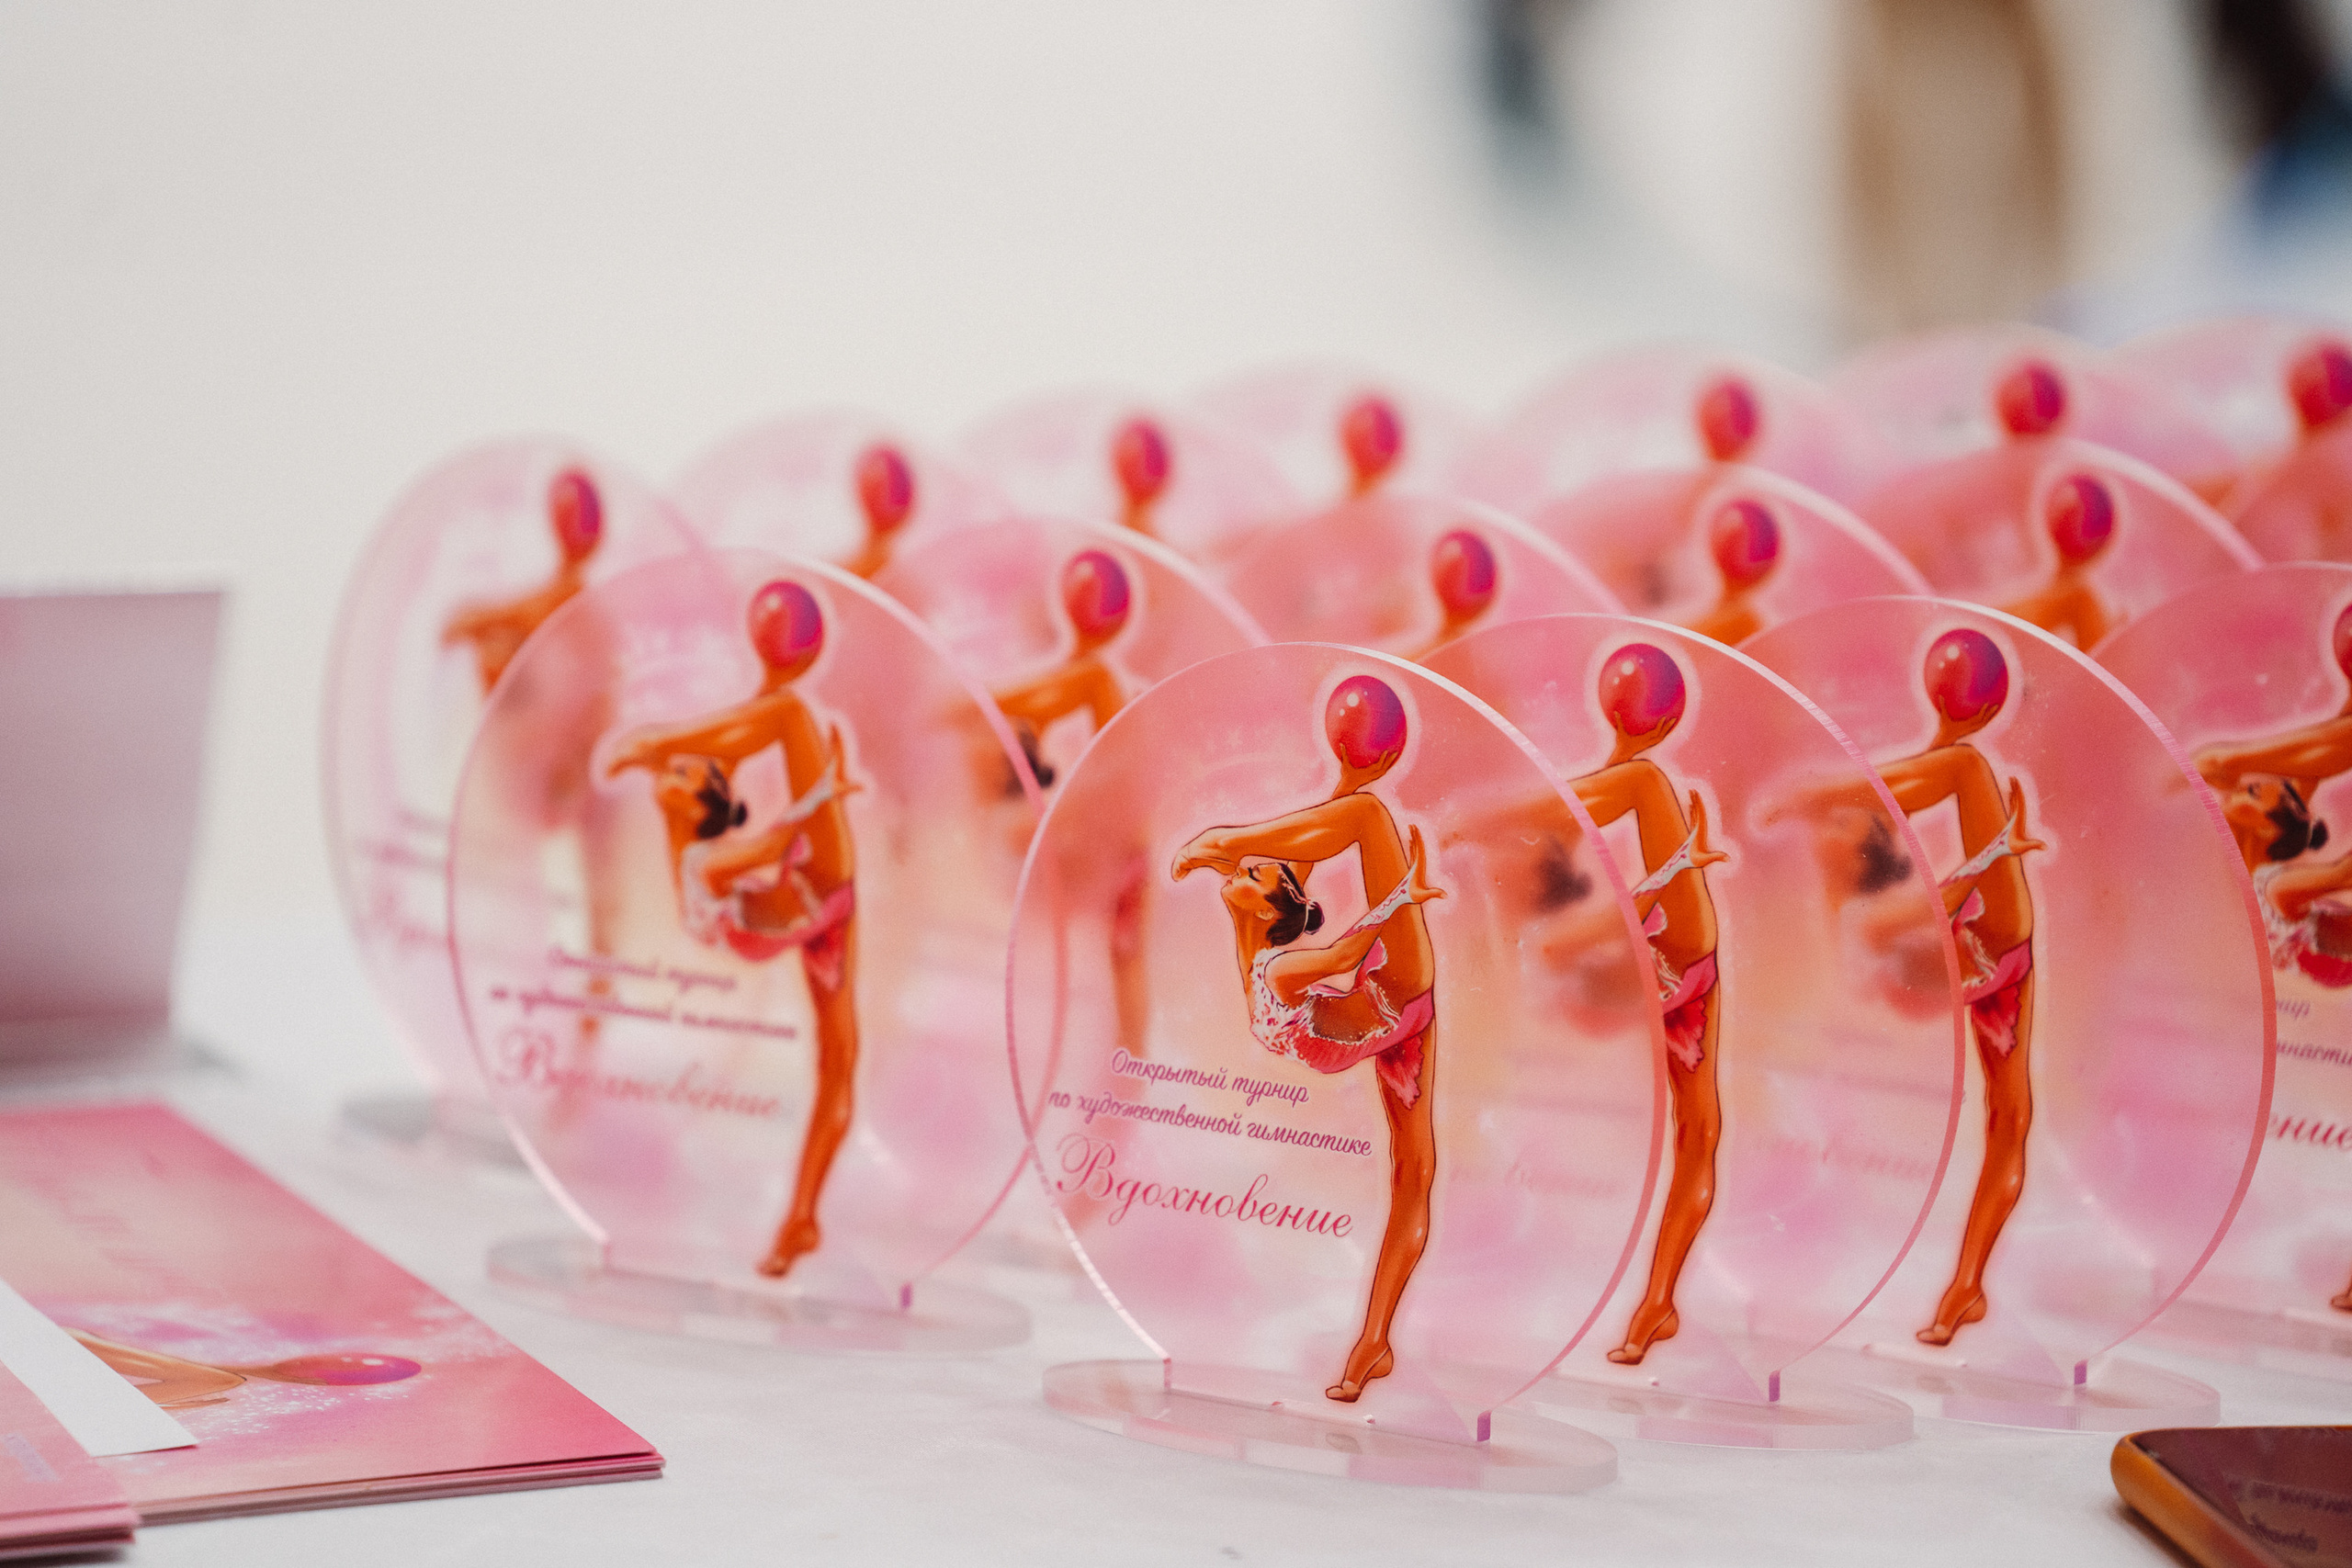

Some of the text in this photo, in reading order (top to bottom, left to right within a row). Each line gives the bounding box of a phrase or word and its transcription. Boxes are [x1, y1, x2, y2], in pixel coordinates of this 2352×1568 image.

[1111, 1049, 1310, 1108] Открытый турнир
[1048, 1090, 1373, 1156] по художественной гимнастике
[1056, 1133, 1353, 1238] Вдохновение
